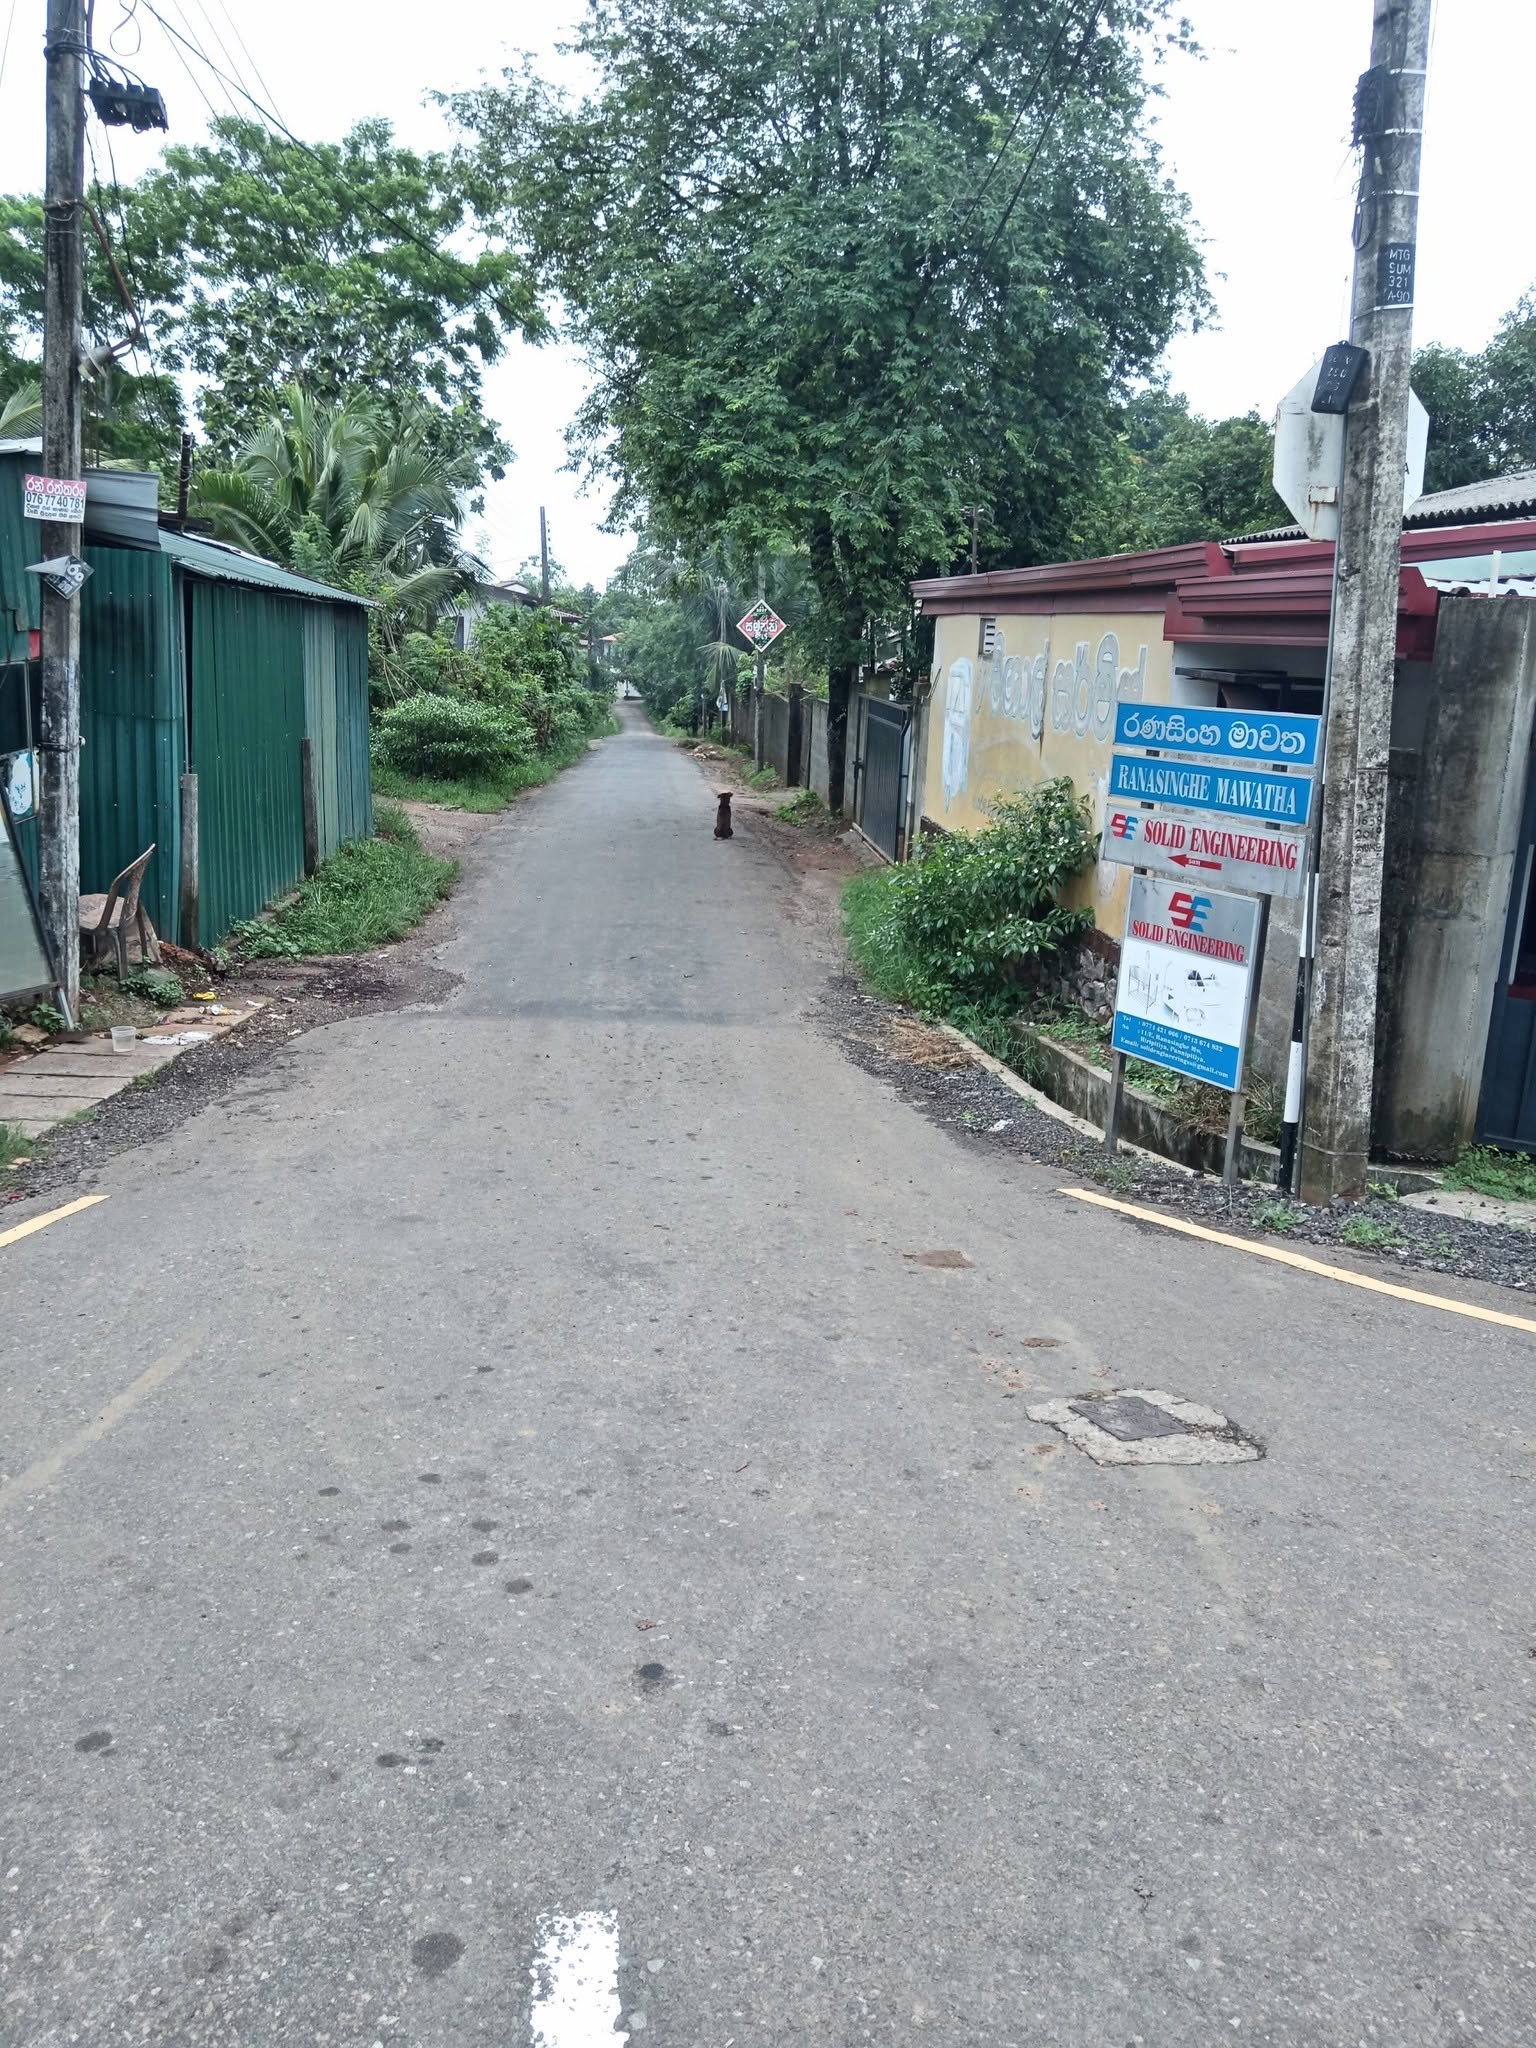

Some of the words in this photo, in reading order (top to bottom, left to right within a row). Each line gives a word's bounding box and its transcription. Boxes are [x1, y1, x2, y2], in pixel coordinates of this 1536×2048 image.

[1389, 248, 1411, 260] MTG
[1389, 262, 1411, 274] SUM
[1389, 275, 1408, 288] 321
[26, 491, 43, 505] 076
[1123, 712, 1222, 747] රණසිංහ
[1227, 720, 1306, 755] මාවත
[1117, 764, 1211, 801] RANASINGHE
[1215, 777, 1297, 815] MAWATHA
[1143, 820, 1186, 849] SOLID
[1190, 827, 1298, 871] ENGINEERING
[1132, 920, 1163, 942] SOLID
[1166, 929, 1245, 962] ENGINEERING
